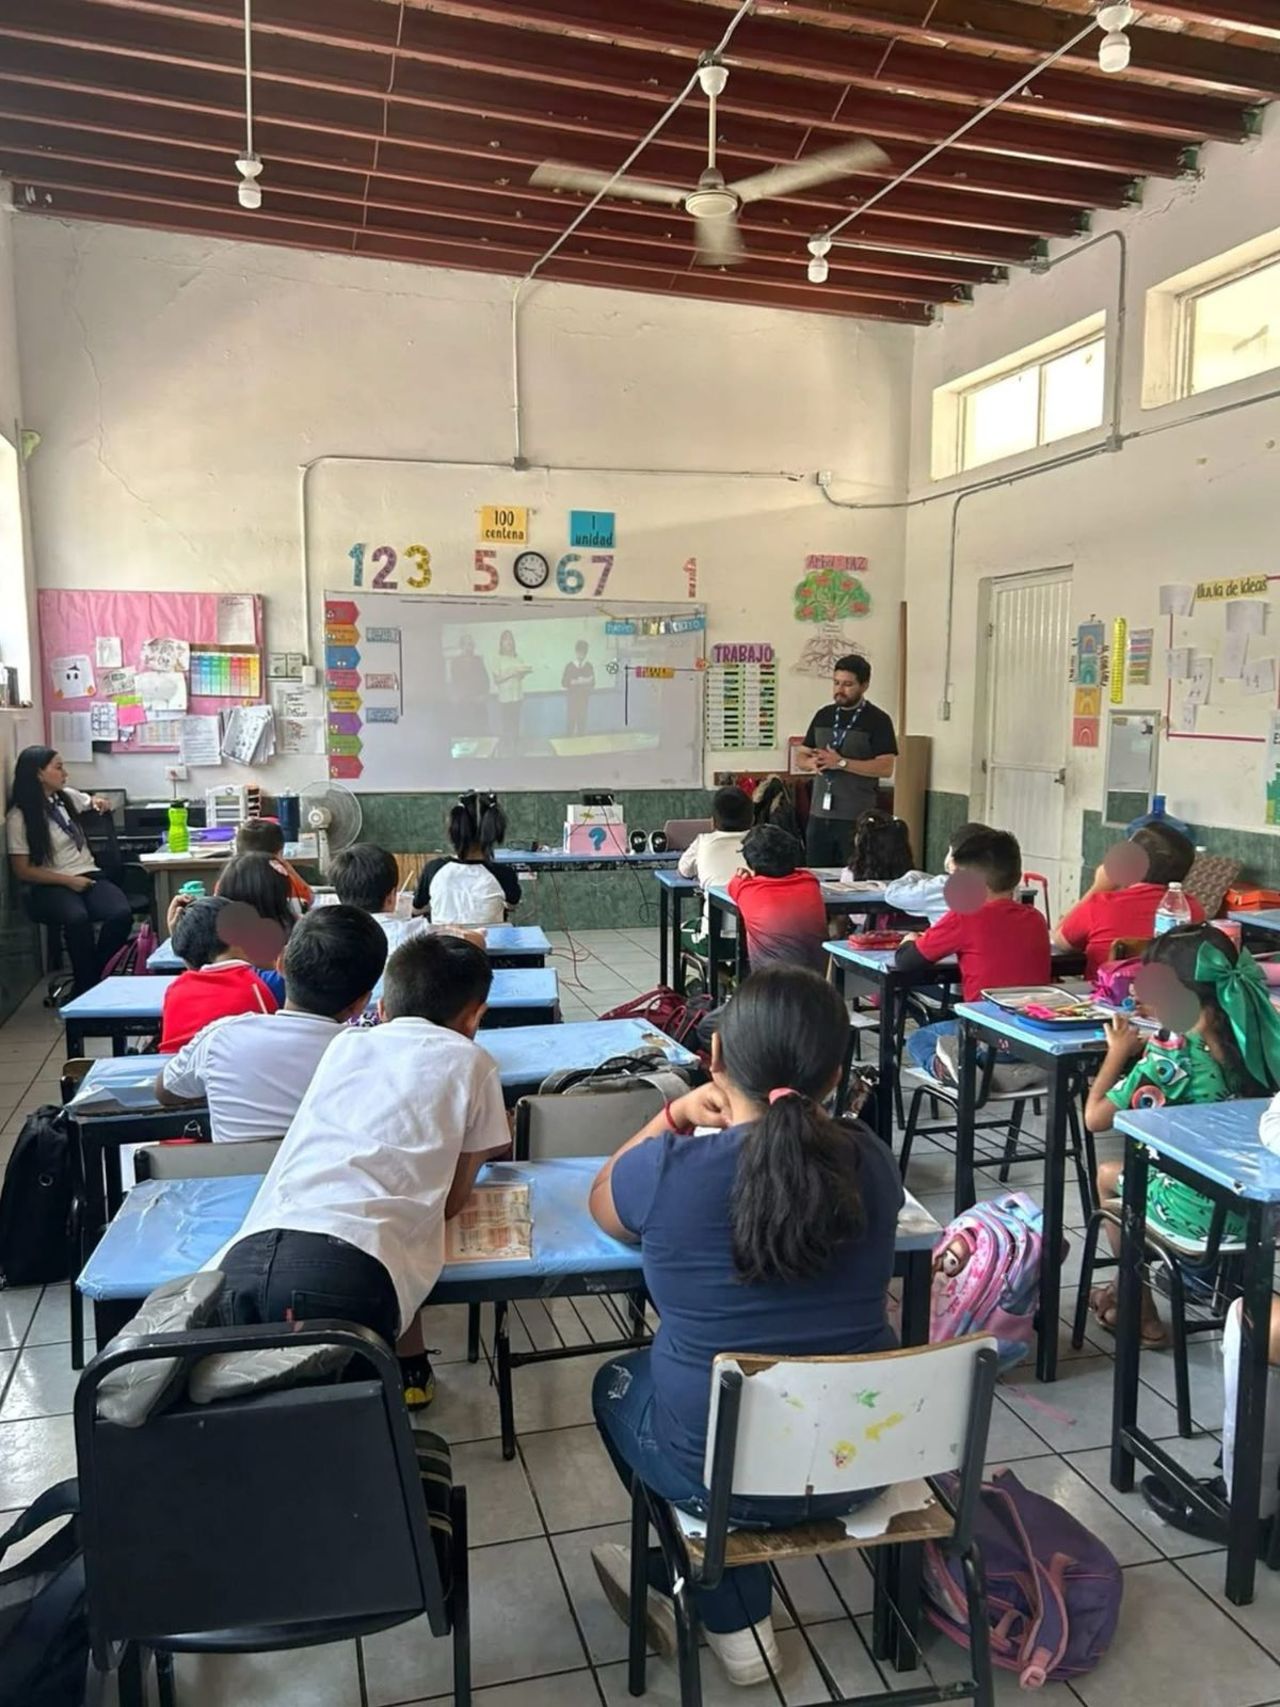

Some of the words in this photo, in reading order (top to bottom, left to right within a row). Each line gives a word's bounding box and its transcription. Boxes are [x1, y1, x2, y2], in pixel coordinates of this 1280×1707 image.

[494, 510, 515, 526] 100
[485, 527, 524, 540] centena
[574, 532, 614, 546] unidad
[473, 549, 499, 592] 5
[713, 644, 775, 664] TRABAJO
